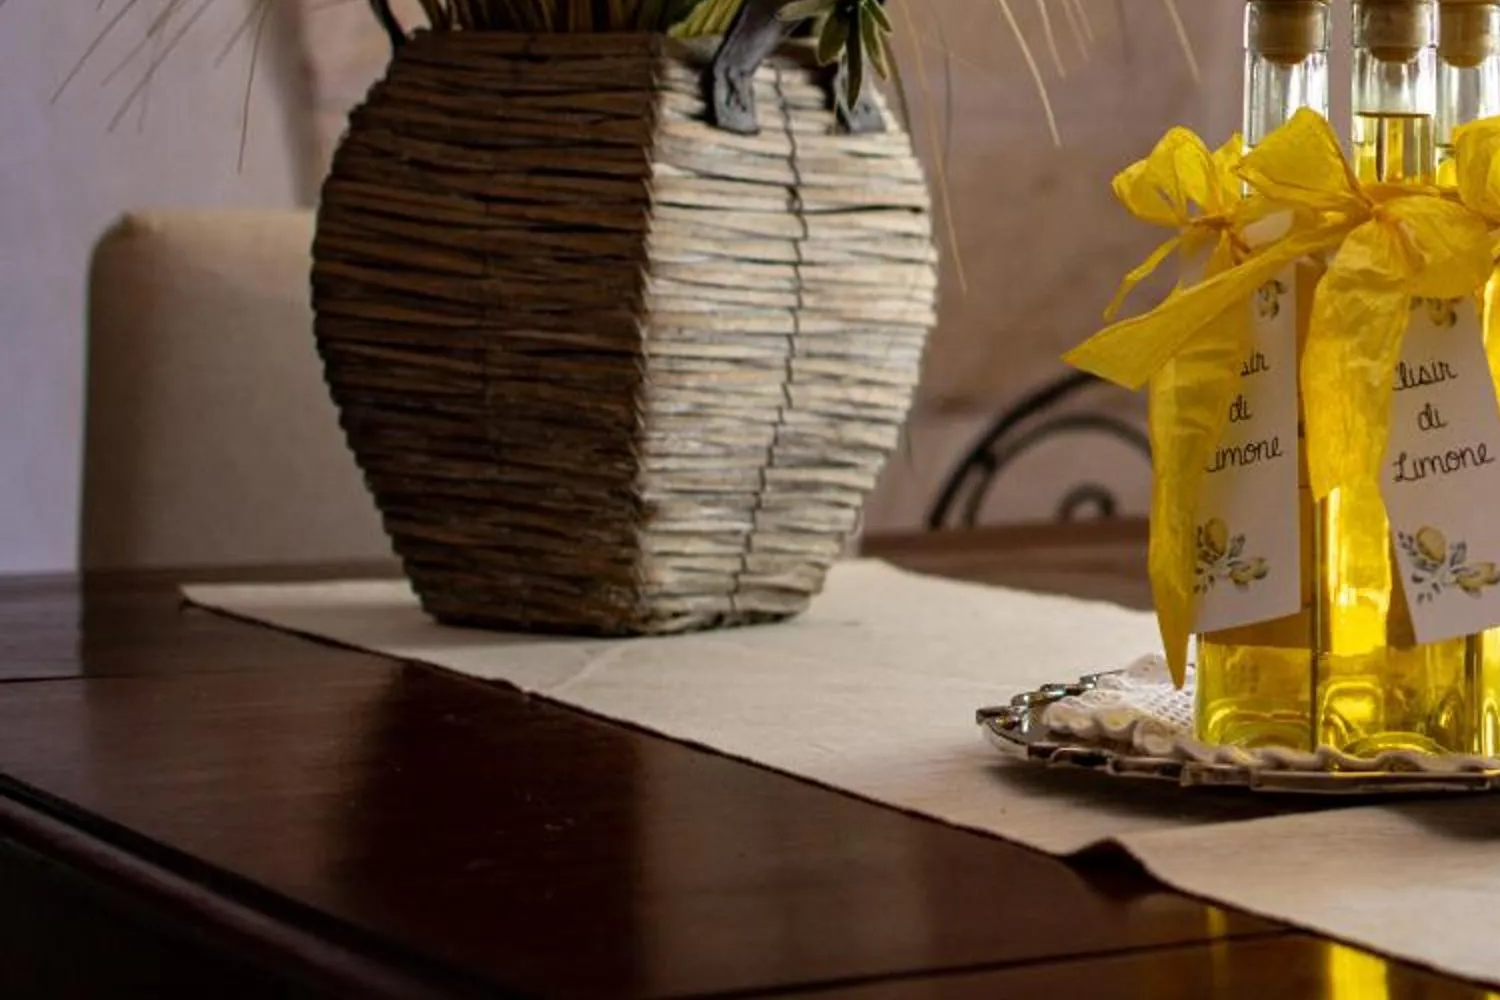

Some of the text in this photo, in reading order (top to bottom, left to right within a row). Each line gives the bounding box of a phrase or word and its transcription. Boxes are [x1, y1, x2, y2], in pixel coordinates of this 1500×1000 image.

[1229, 393, 1254, 424] di
[1417, 402, 1449, 431] di
[1392, 443, 1496, 484] Limone
